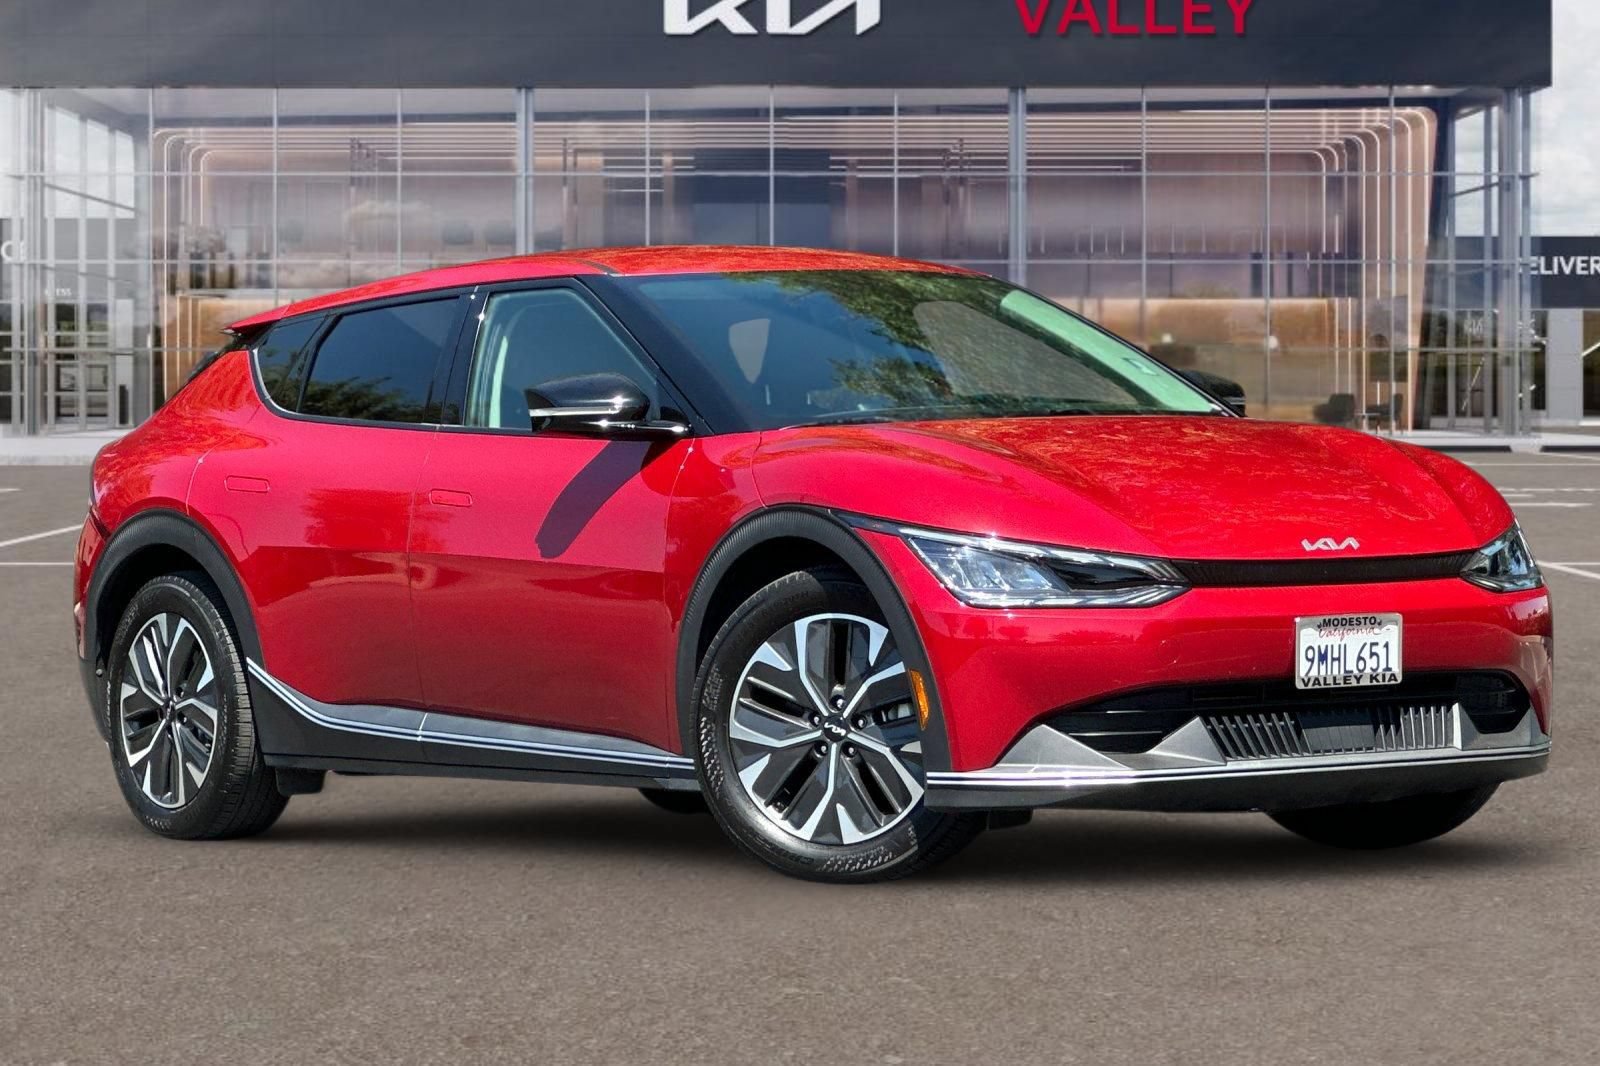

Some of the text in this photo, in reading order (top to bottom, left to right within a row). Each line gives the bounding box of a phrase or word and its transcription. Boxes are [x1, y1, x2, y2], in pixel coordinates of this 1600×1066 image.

[663, 0, 881, 36] KIA
[1015, 0, 1255, 35] VALLEY
[1301, 537, 1360, 551] KIA
[1322, 616, 1377, 628] MODESTO
[1304, 641, 1393, 677] 9MHL651
[1301, 672, 1398, 688] VALLEY KIA
